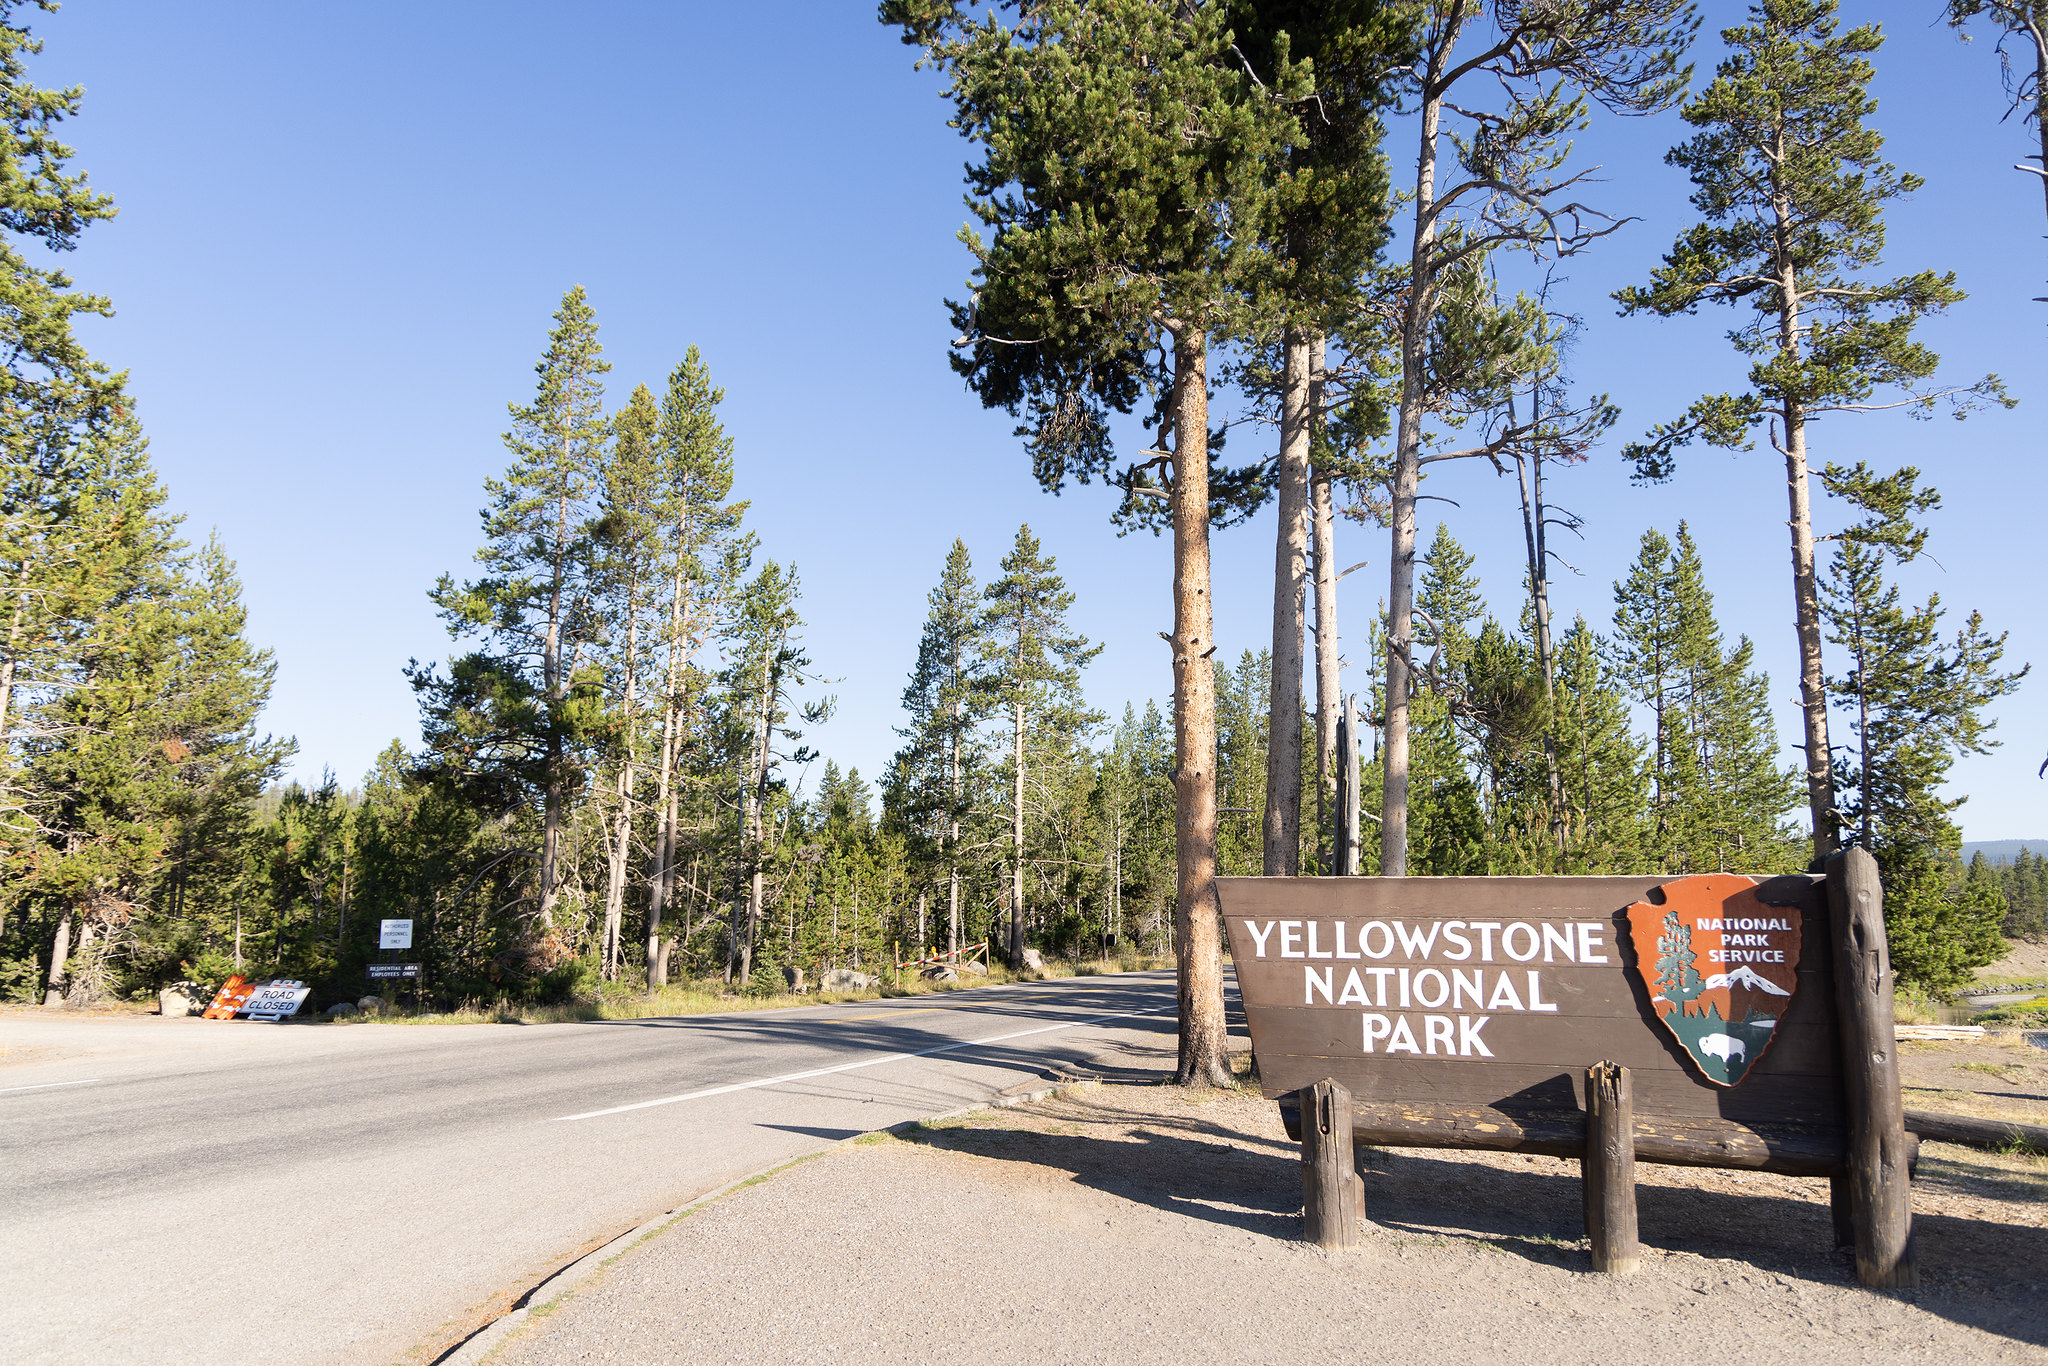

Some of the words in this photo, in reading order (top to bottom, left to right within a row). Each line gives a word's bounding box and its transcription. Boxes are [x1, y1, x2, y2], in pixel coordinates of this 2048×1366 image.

[1696, 917, 1792, 931] NATIONAL
[1243, 920, 1608, 964] YELLOWSTONE
[1720, 934, 1769, 947] PARK
[1708, 949, 1785, 963] SERVICE
[261, 990, 295, 1000] ROAD
[1304, 966, 1559, 1012] NATIONAL
[248, 1000, 295, 1011] CLOSED
[1361, 1013, 1496, 1058] PARK
